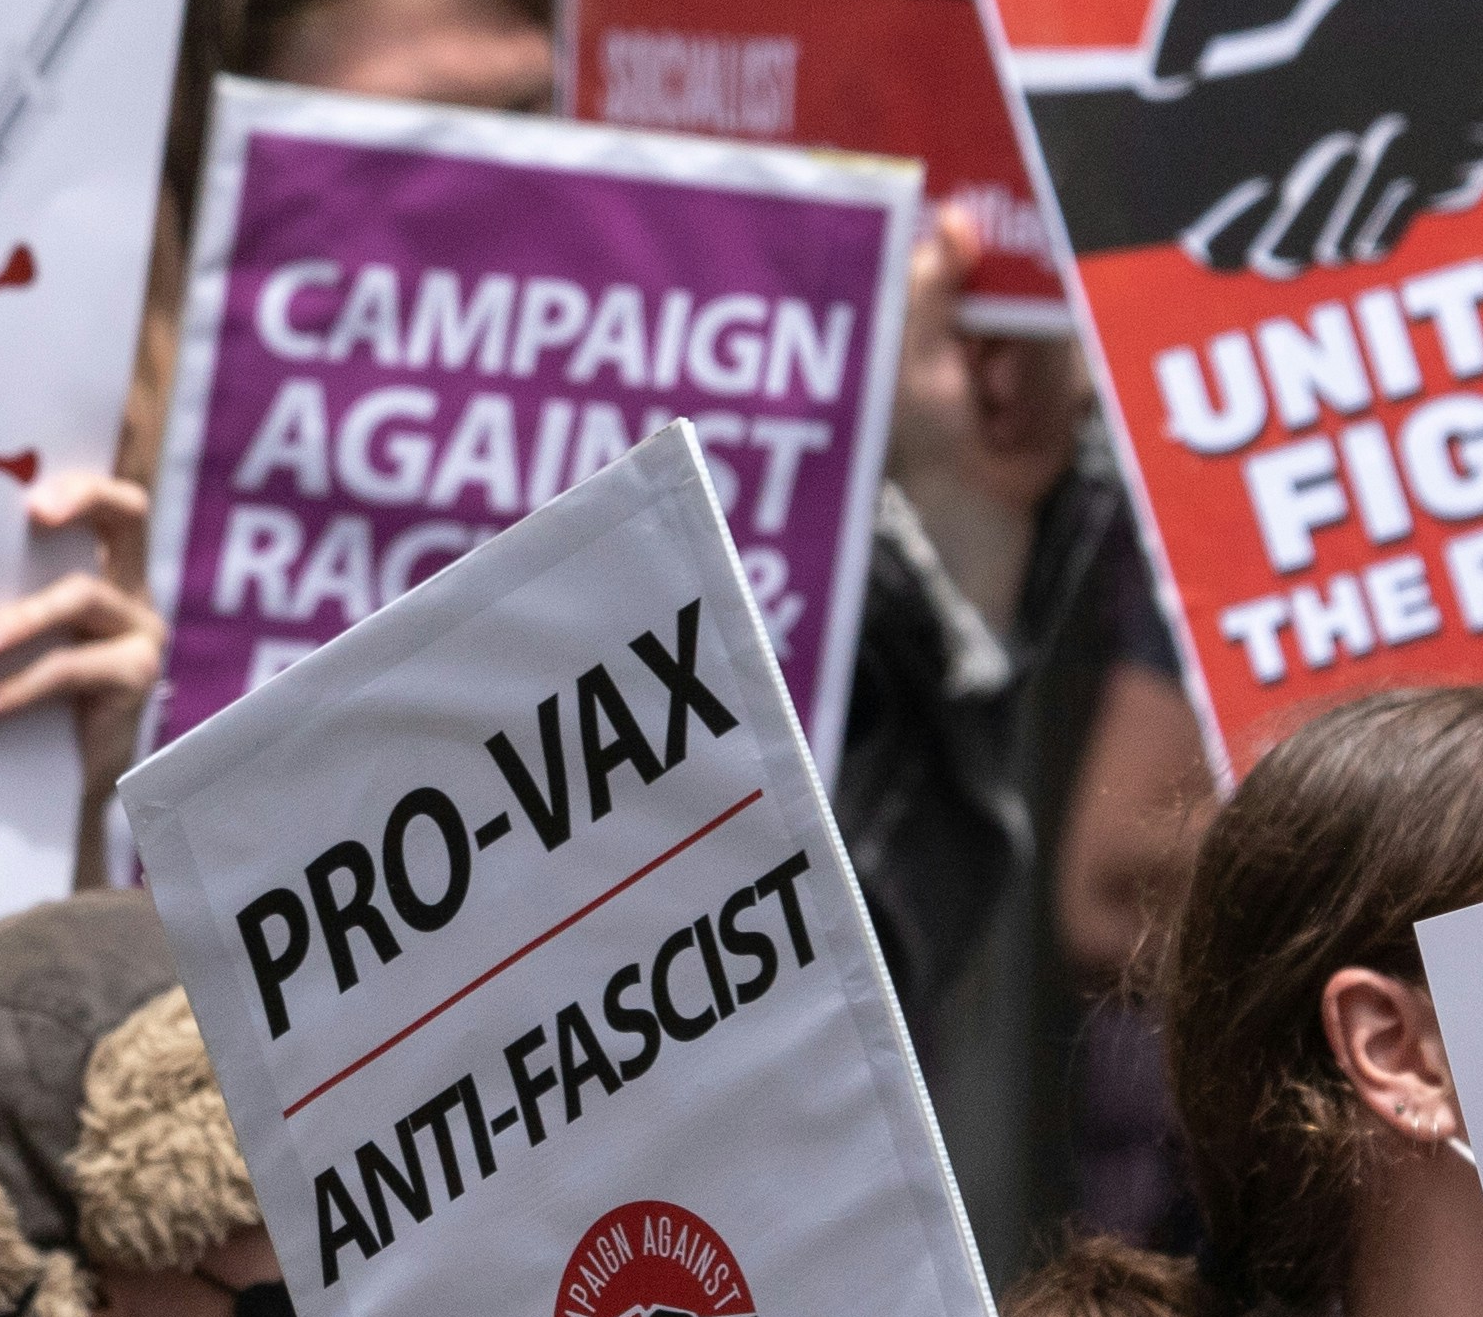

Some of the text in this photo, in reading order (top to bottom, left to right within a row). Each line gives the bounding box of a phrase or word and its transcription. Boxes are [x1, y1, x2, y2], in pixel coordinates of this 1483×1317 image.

[256, 262, 851, 402] CAMPAIGN
[216, 507, 501, 622] RAC
[1219, 555, 1441, 682] THE
[234, 596, 741, 1042] PRO-VAX
[311, 847, 817, 1290] ANTI-FASCIST
[643, 1215, 742, 1311] AGAINST
